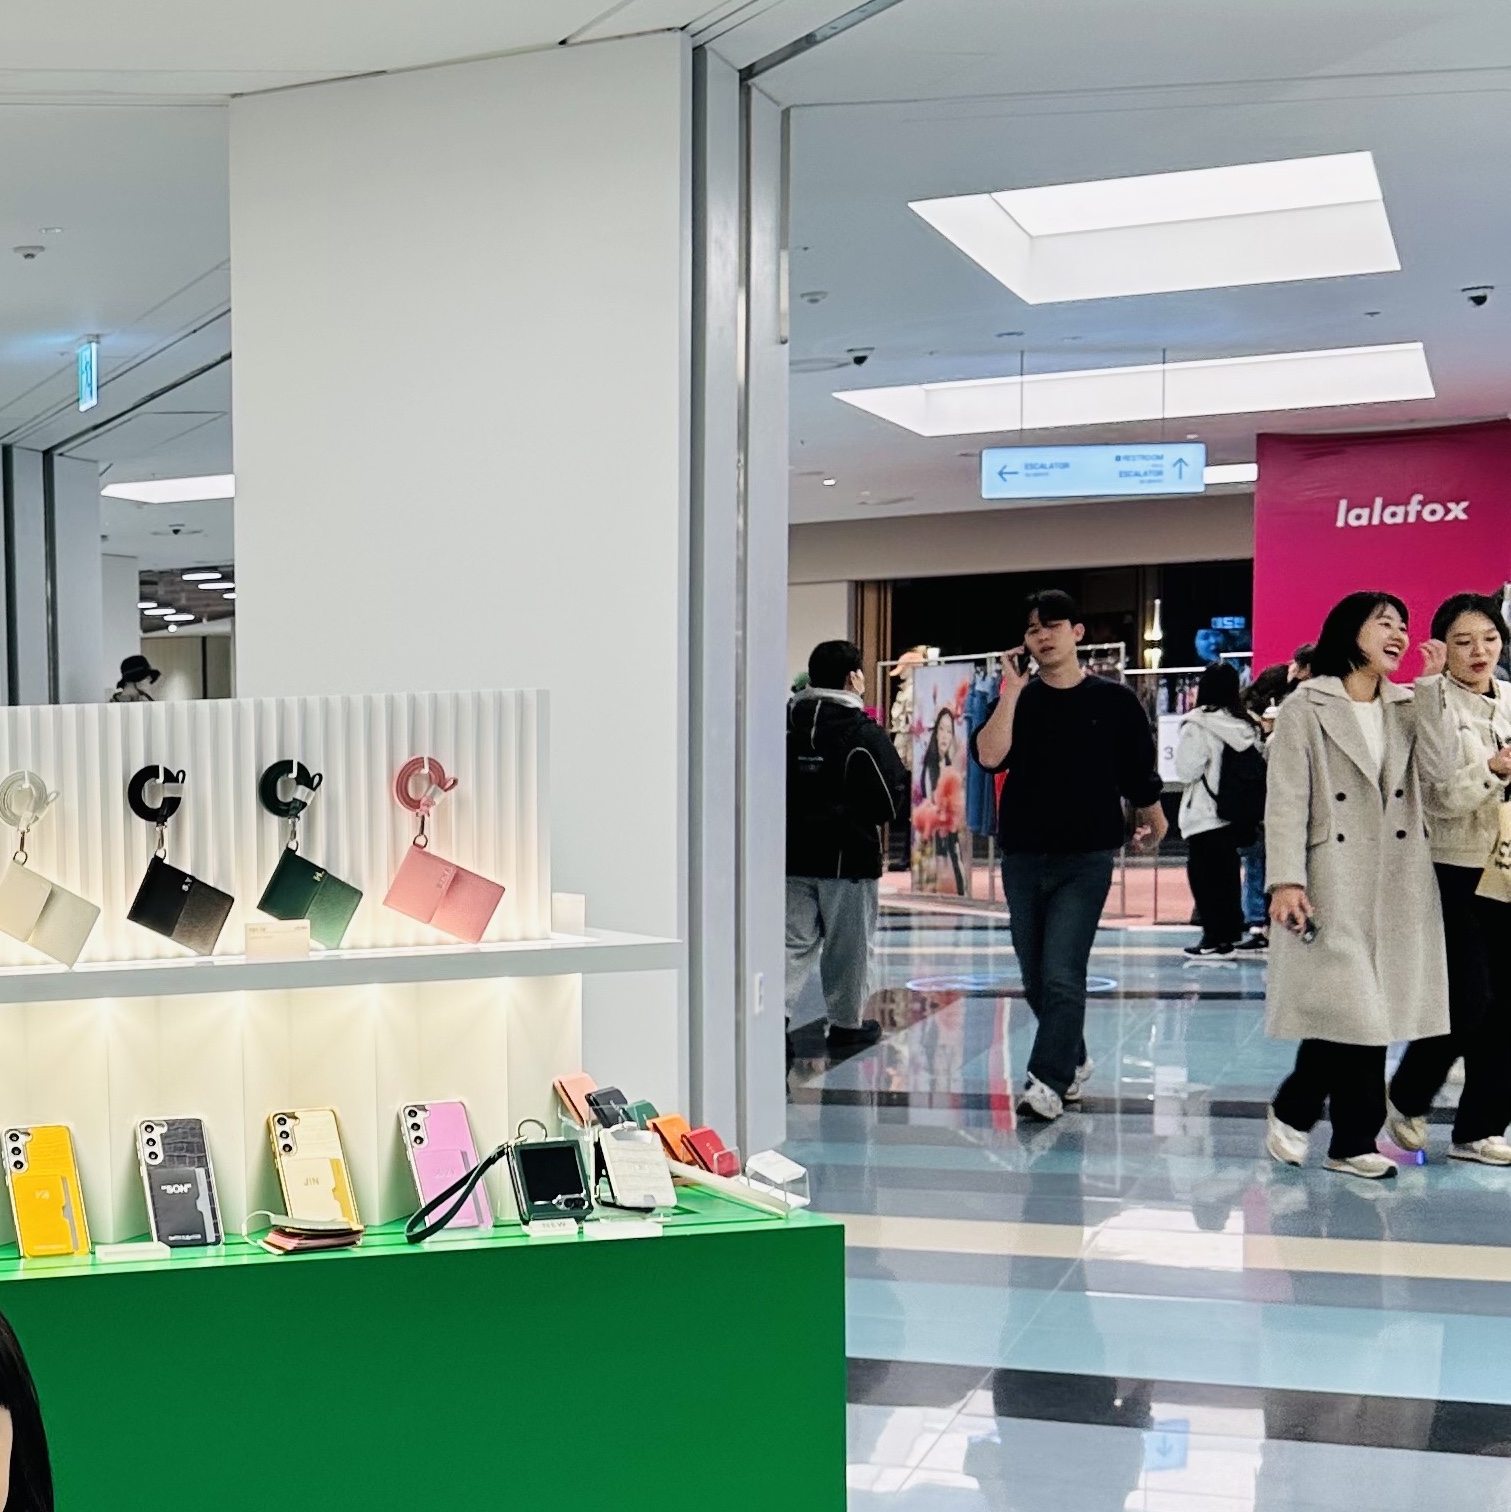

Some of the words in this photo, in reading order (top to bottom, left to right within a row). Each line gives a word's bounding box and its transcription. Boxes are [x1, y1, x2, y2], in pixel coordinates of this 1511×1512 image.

[1023, 462, 1070, 471] ESCALATOR
[1118, 469, 1165, 478] ESCALATOR
[1335, 493, 1470, 528] lalafox
